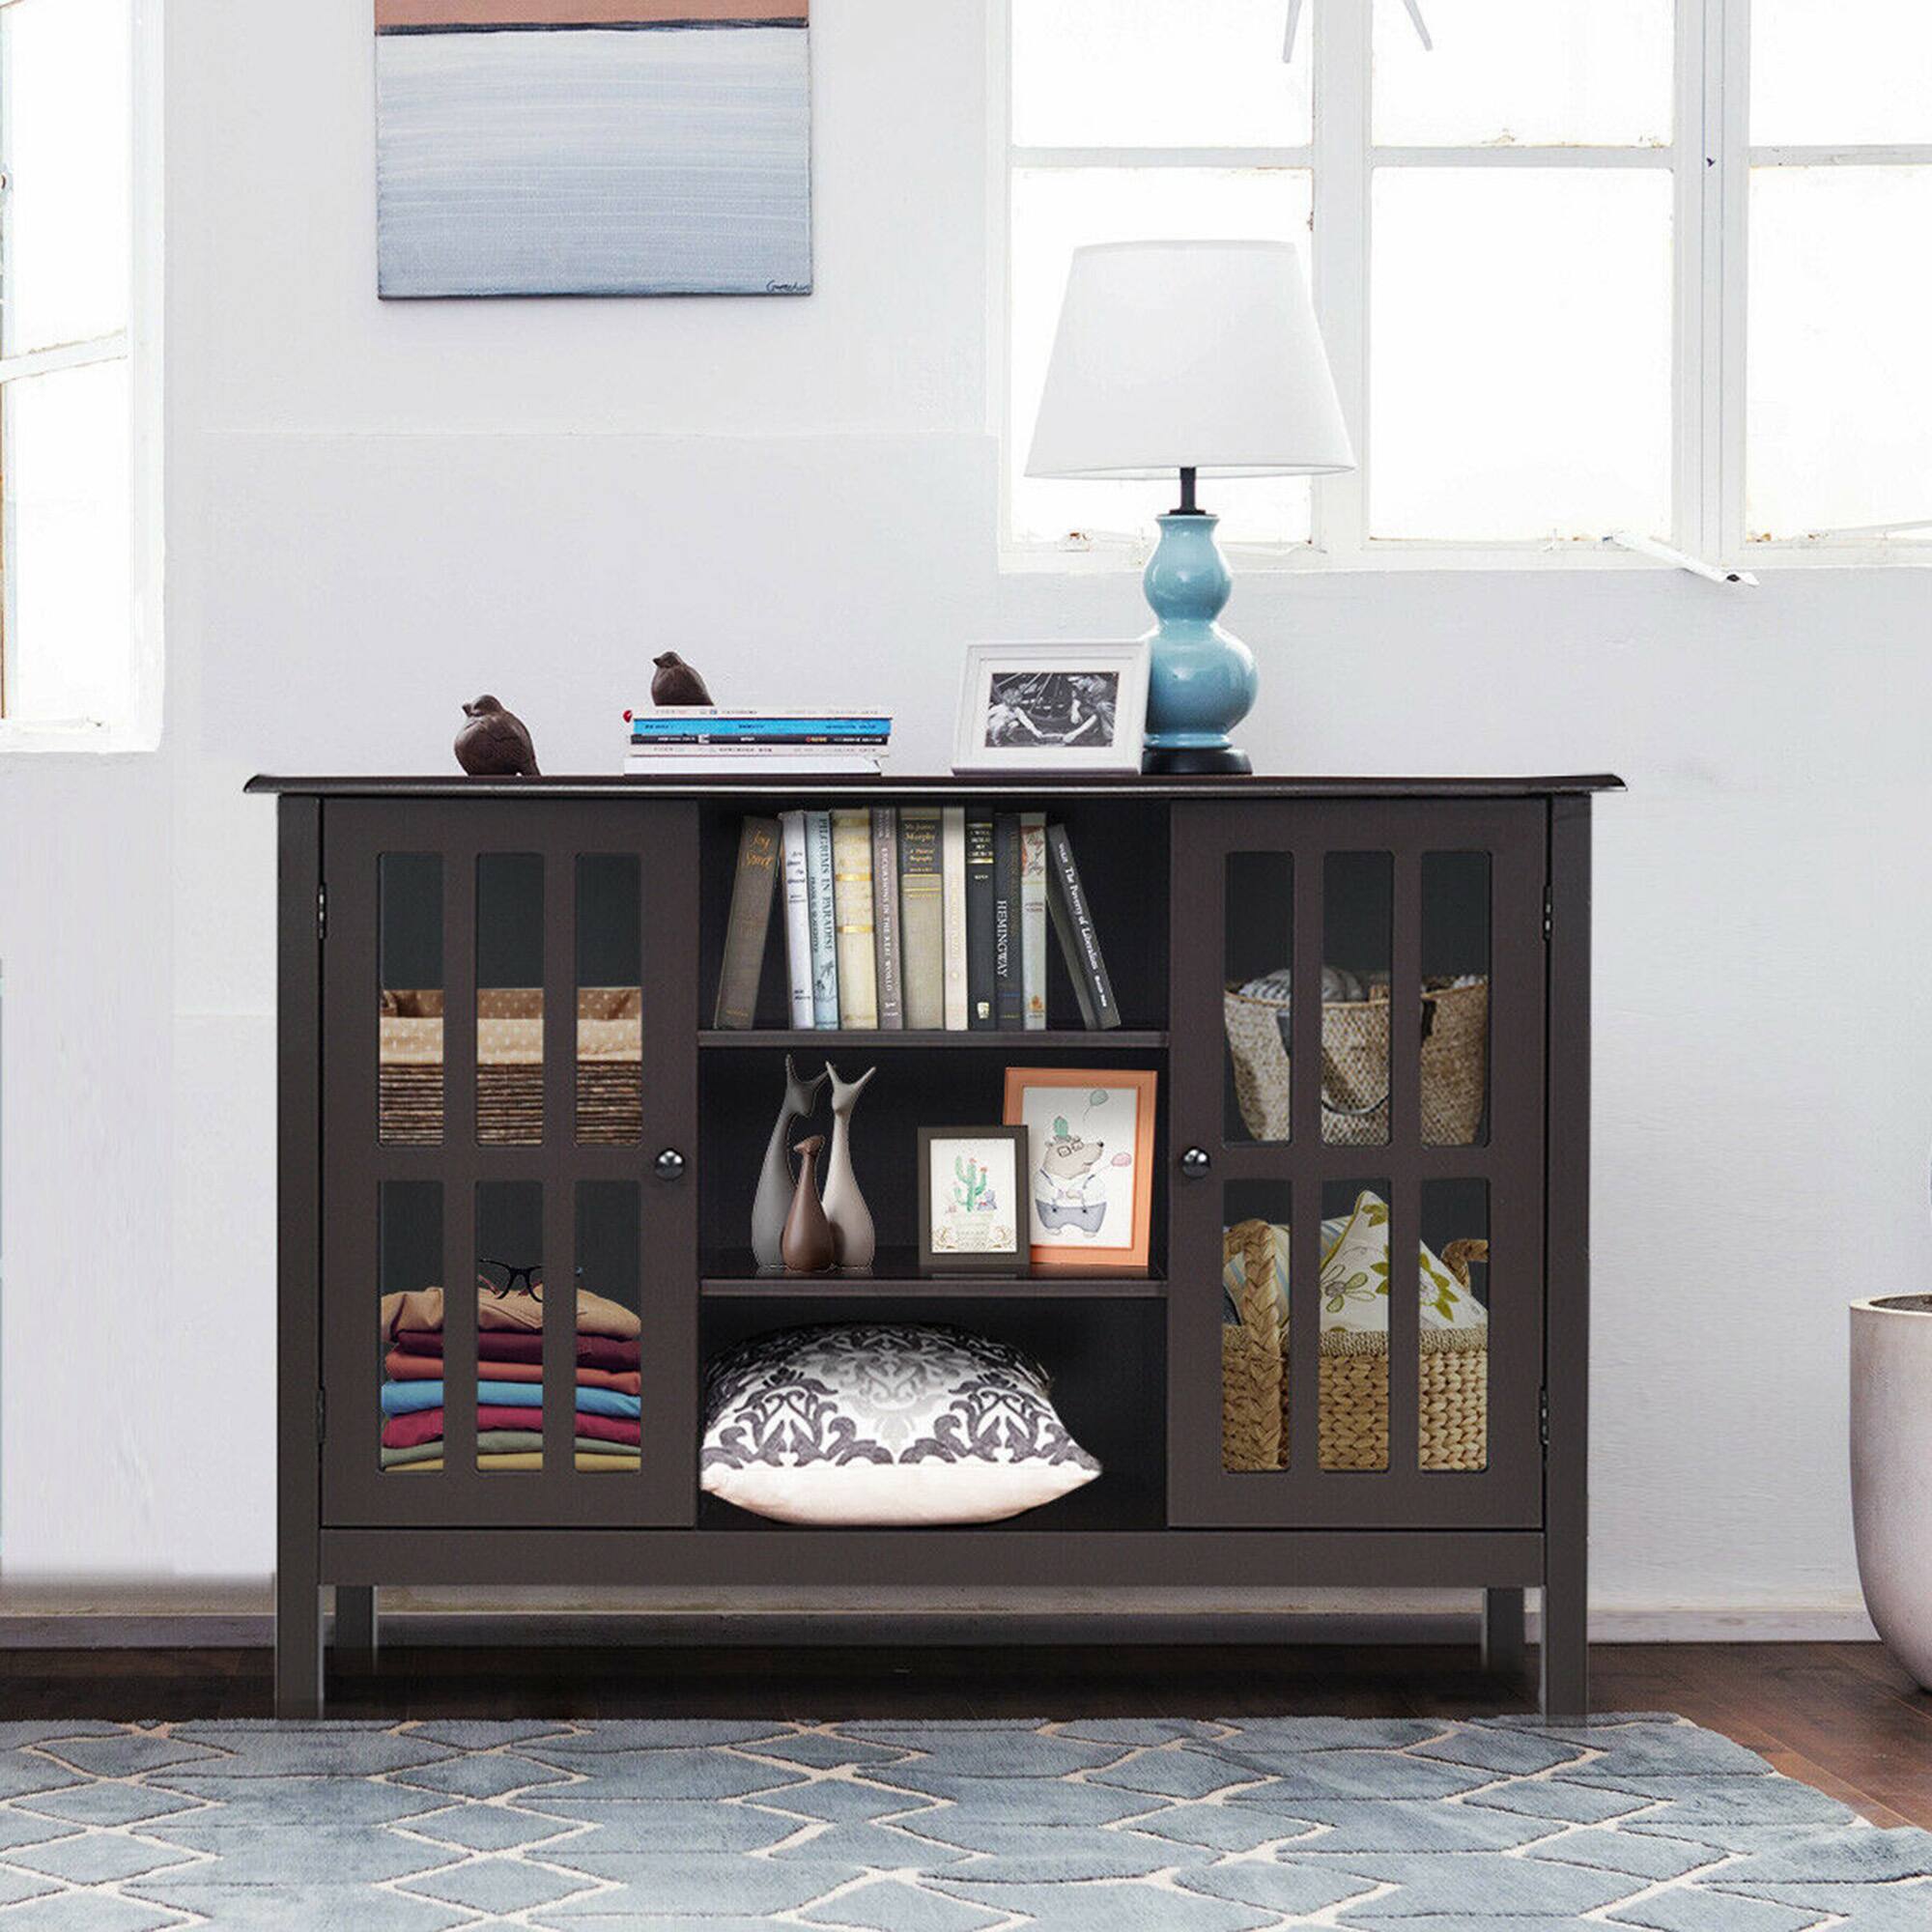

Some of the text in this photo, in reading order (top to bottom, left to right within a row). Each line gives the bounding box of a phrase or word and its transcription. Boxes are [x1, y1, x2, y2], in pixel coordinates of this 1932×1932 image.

[819, 818, 833, 949] PILGRIMS IN PARADISE
[1065, 867, 1075, 882] The
[1069, 884, 1083, 915] Poverty
[997, 900, 1008, 978] HEMINGWAY
